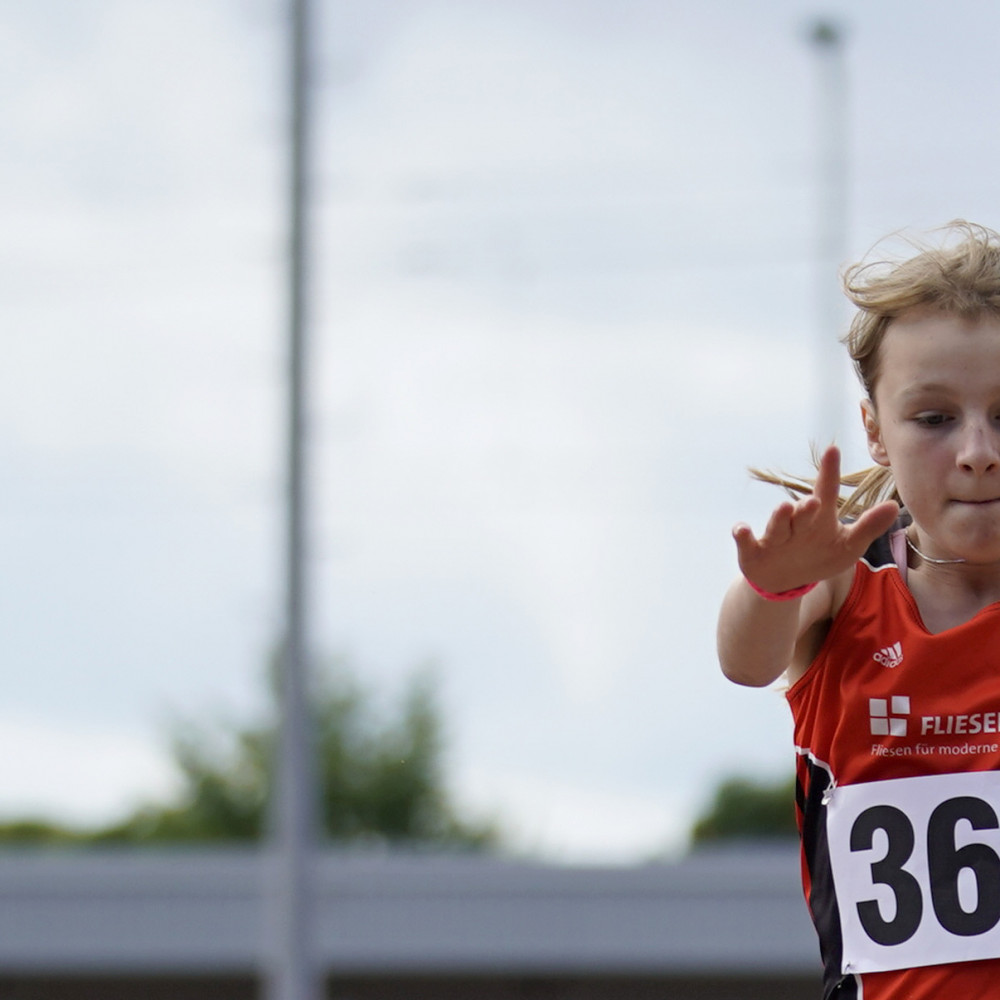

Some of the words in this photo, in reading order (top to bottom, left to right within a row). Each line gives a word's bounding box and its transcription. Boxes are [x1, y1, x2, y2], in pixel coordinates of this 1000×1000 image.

[873, 651, 904, 668] adidas
[871, 744, 912, 757] Fliesen
[915, 743, 935, 755] für
[939, 742, 998, 755] moderne
